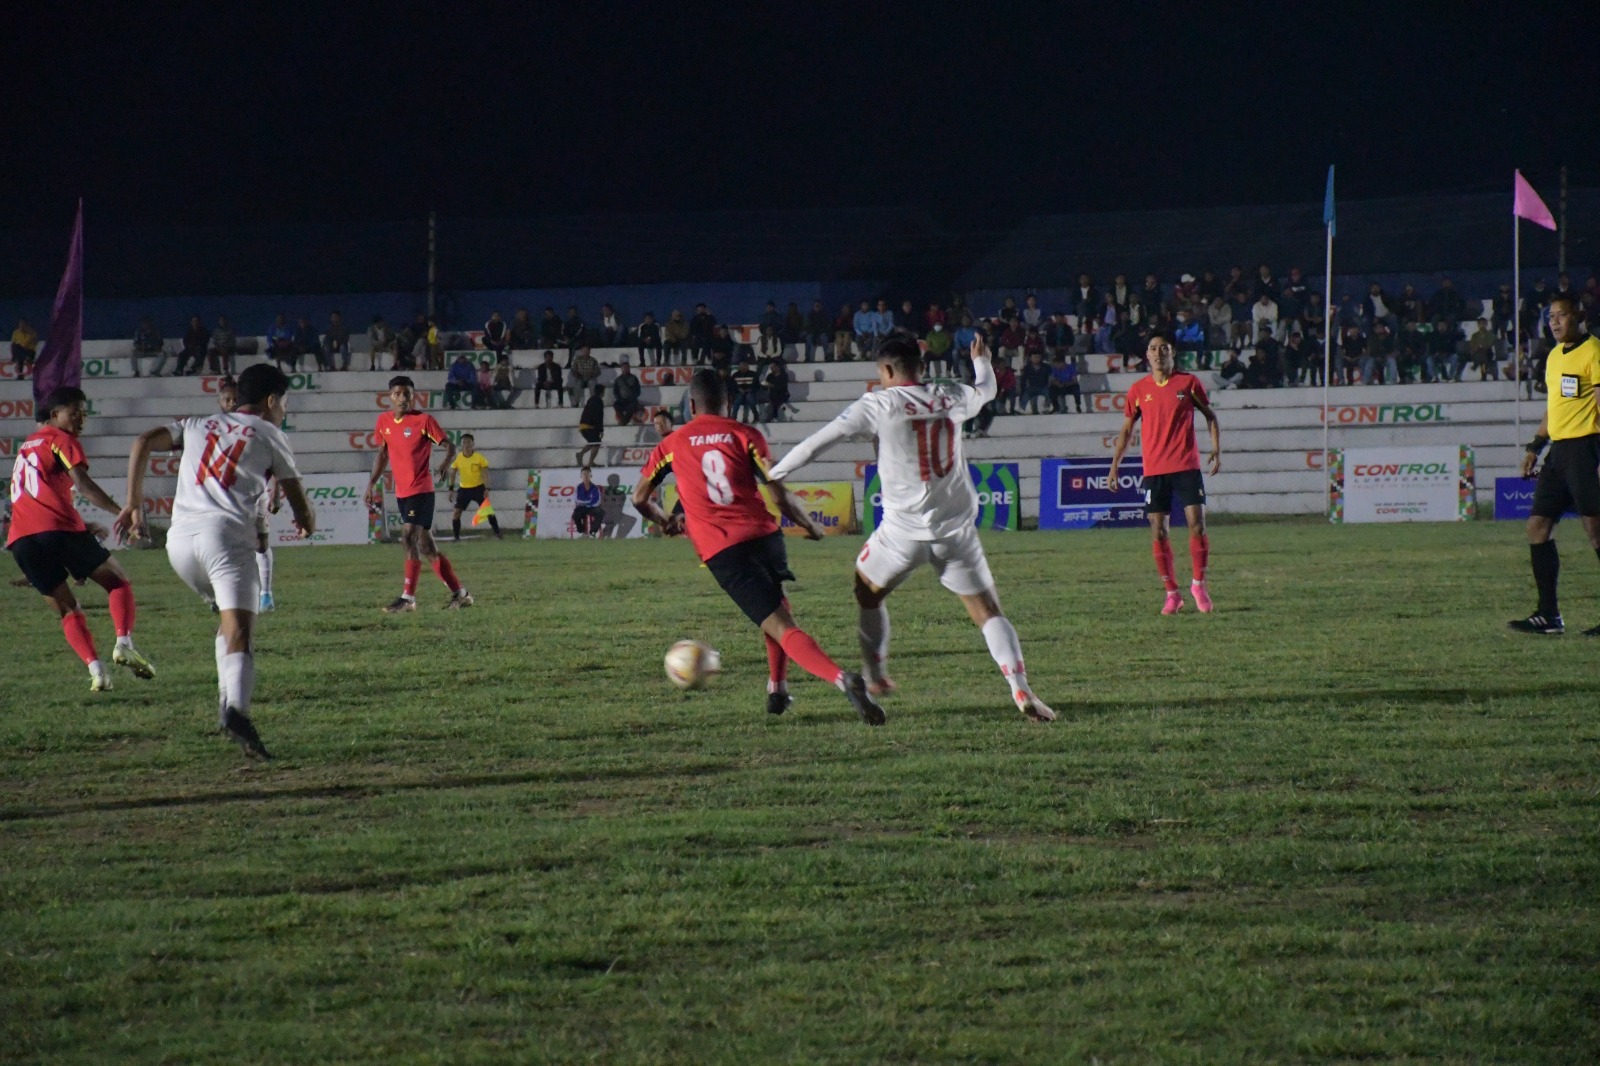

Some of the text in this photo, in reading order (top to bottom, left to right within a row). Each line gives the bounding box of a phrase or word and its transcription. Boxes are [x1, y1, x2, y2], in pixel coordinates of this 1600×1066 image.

[1319, 403, 1447, 424] CONTROL
[689, 433, 733, 447] TANKA
[911, 416, 955, 482] 10
[195, 431, 248, 492] 14
[1353, 463, 1448, 476] CONTROL
[701, 449, 734, 506] 8
[977, 491, 1014, 505] ORE
